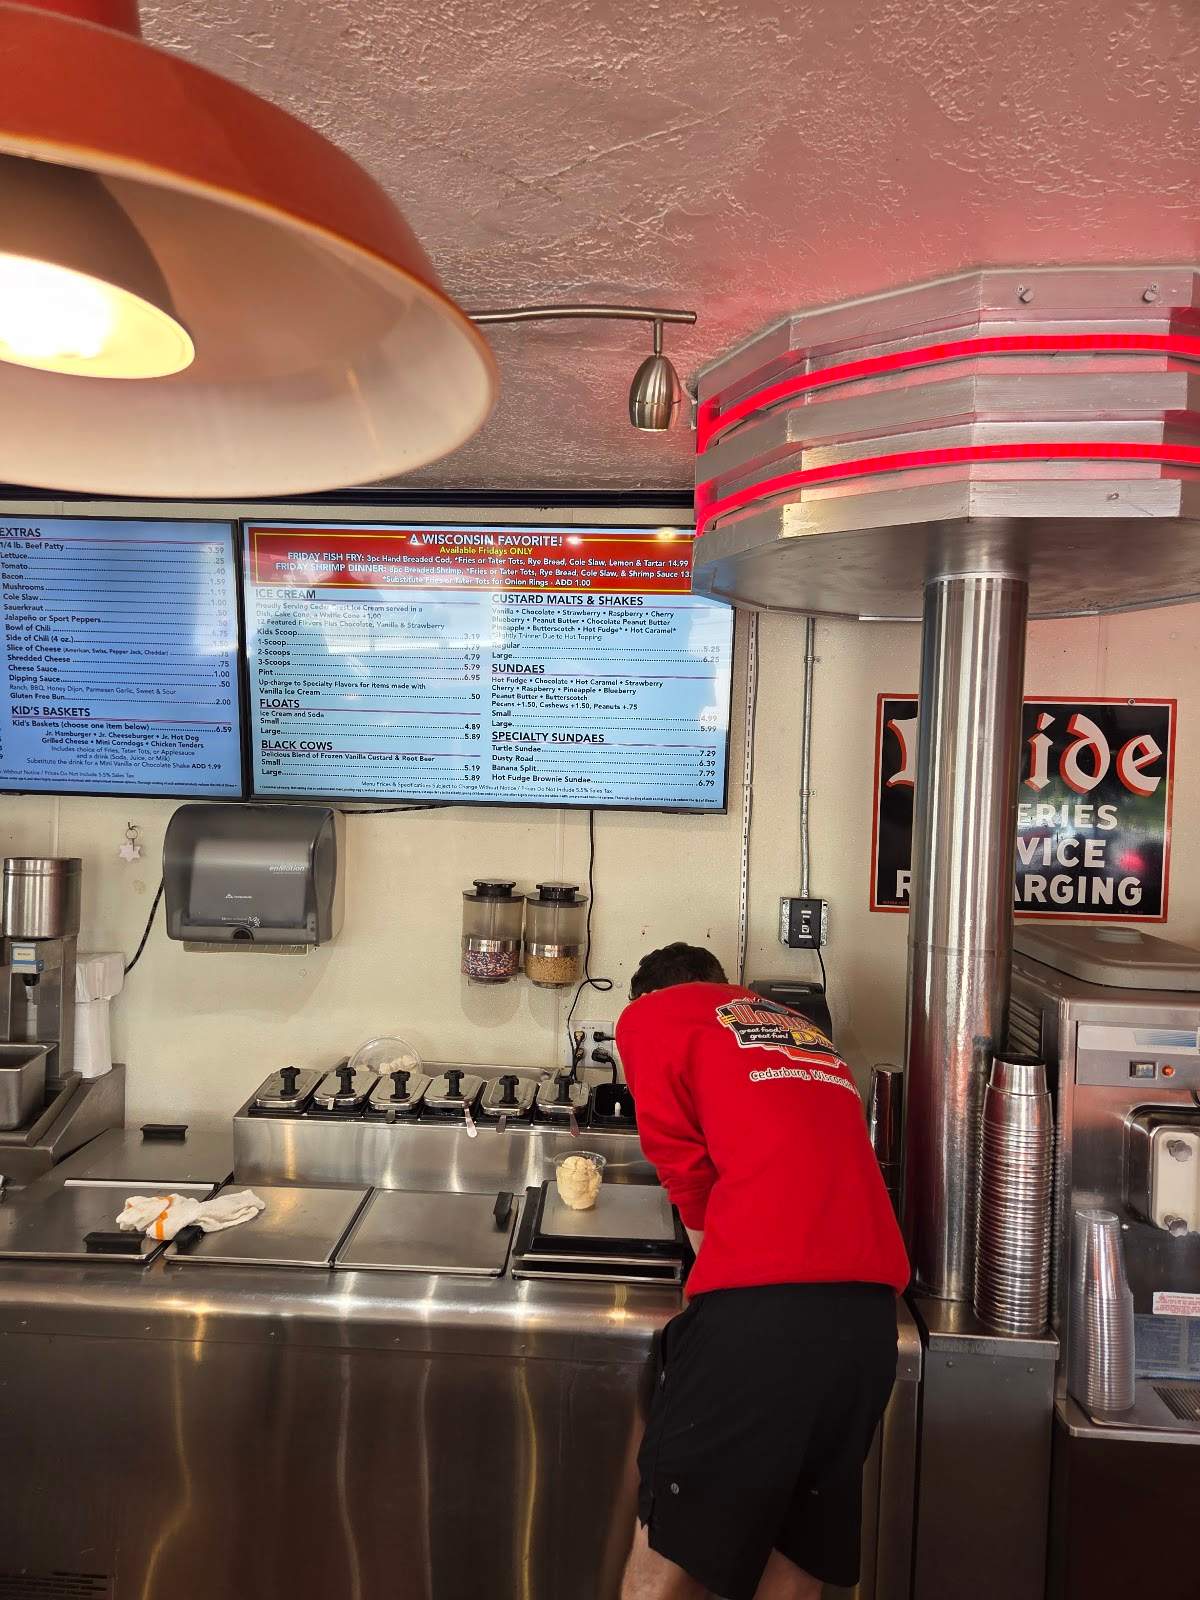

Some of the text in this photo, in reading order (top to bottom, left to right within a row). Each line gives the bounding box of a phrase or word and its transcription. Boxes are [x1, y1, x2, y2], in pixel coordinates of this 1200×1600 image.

[0, 528, 41, 537] EXTRAS
[410, 534, 563, 546] A WISCONSIN FAVORITE!
[45, 543, 64, 551] Patty
[440, 546, 476, 554] Available
[478, 546, 507, 556] Fridays
[323, 553, 343, 561] FISH
[367, 555, 380, 563] 3pc
[435, 556, 452, 564] Cod,
[528, 558, 541, 567] Rye
[543, 558, 566, 566] Bread,
[256, 589, 316, 599] ICE CREAM
[492, 595, 644, 606] CUSTARD MALTS & SHAKES
[5, 614, 37, 622] Jalapeño
[49, 615, 69, 623] Sport
[72, 616, 101, 624] Peppers
[258, 649, 290, 657] 2-Scoops
[8, 654, 42, 662] Shredded
[258, 659, 291, 667] 3-Scoops
[492, 664, 545, 673] SUNDAES
[9, 675, 37, 683] Dipping
[625, 680, 663, 688] Strawberry
[522, 686, 555, 694] Raspberry
[260, 699, 300, 708] FLOATS
[11, 706, 90, 717] KID'S BASKETS
[492, 720, 512, 728] Large
[108, 732, 154, 740] Cheeseburger
[261, 728, 281, 736] Large
[492, 731, 604, 742] SPECIALTY SUNDAES
[262, 740, 333, 750] BLACK COWS
[262, 769, 282, 777] Large
[1017, 803, 1118, 830] ERIES
[1016, 837, 1106, 868] VICE
[750, 1067, 811, 1083] Cedarburg,
